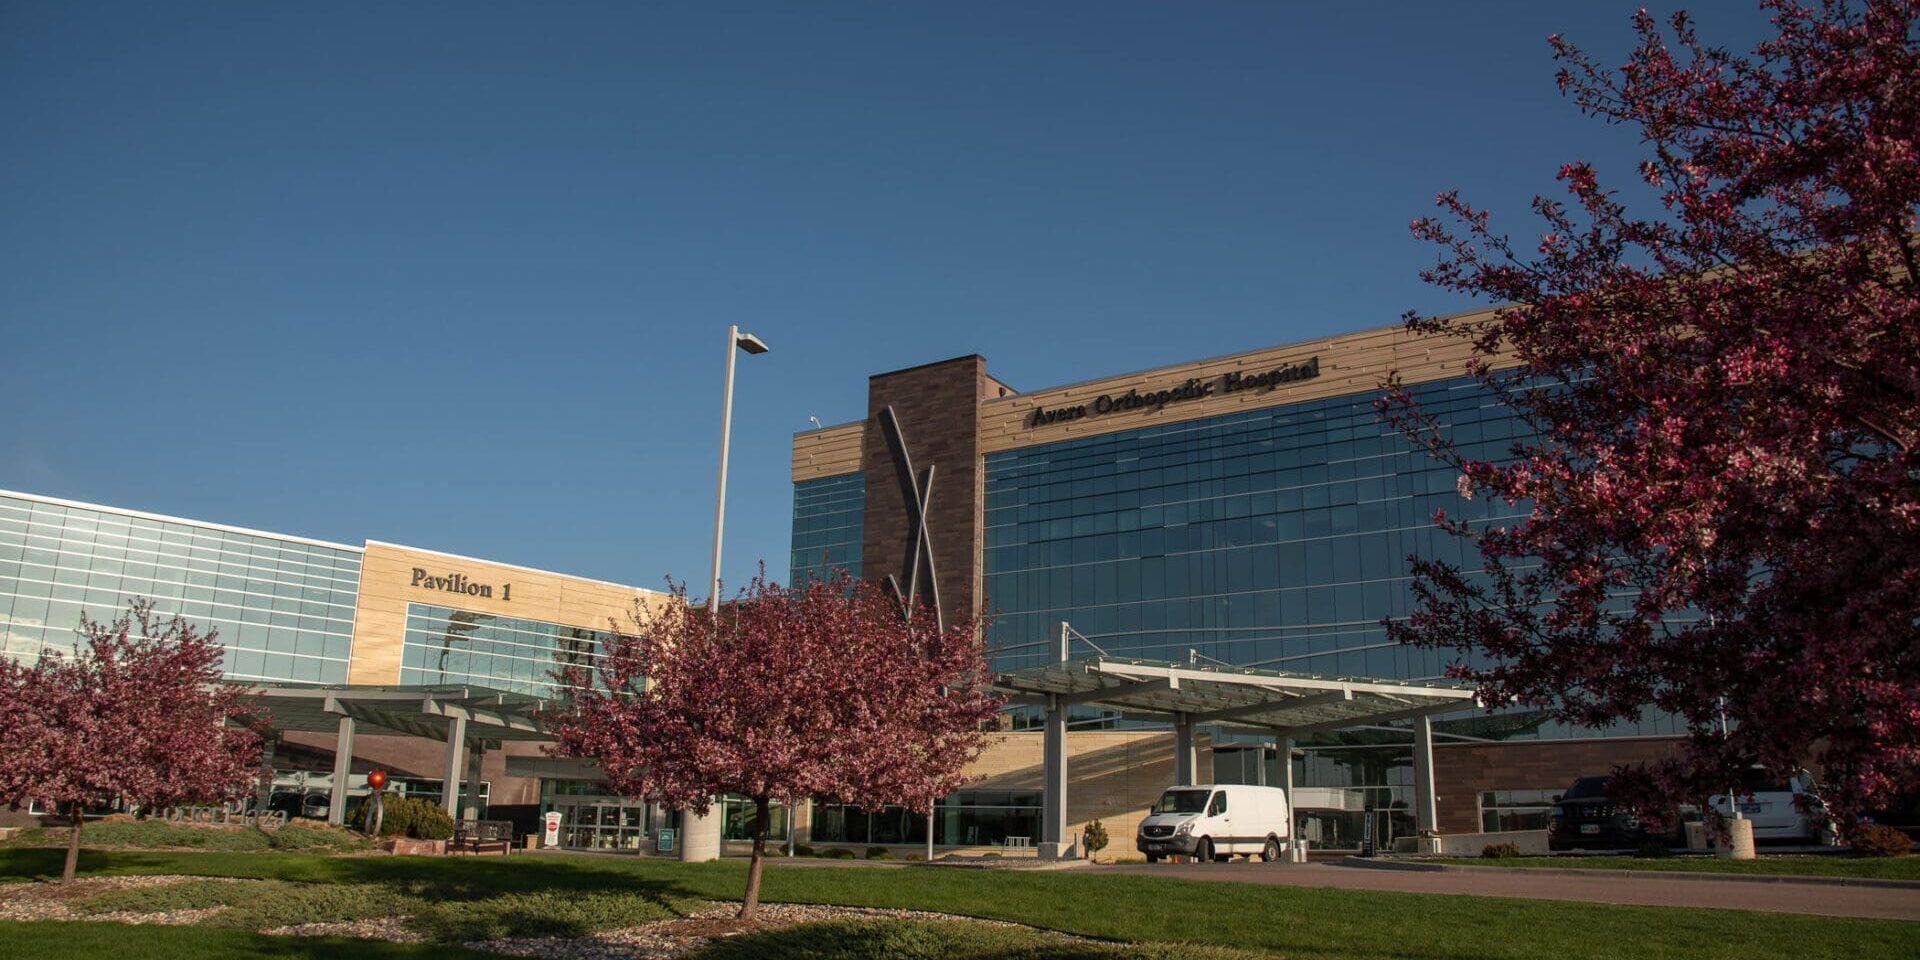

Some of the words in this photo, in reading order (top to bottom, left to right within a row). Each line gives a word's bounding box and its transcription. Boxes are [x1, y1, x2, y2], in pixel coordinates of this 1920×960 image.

[1030, 406, 1086, 427] Avera
[1095, 378, 1214, 413] Orthopedic
[1223, 355, 1320, 392] Hospital
[410, 567, 493, 599] Pavilion
[502, 583, 512, 601] 1
[224, 798, 288, 827] Plaza
